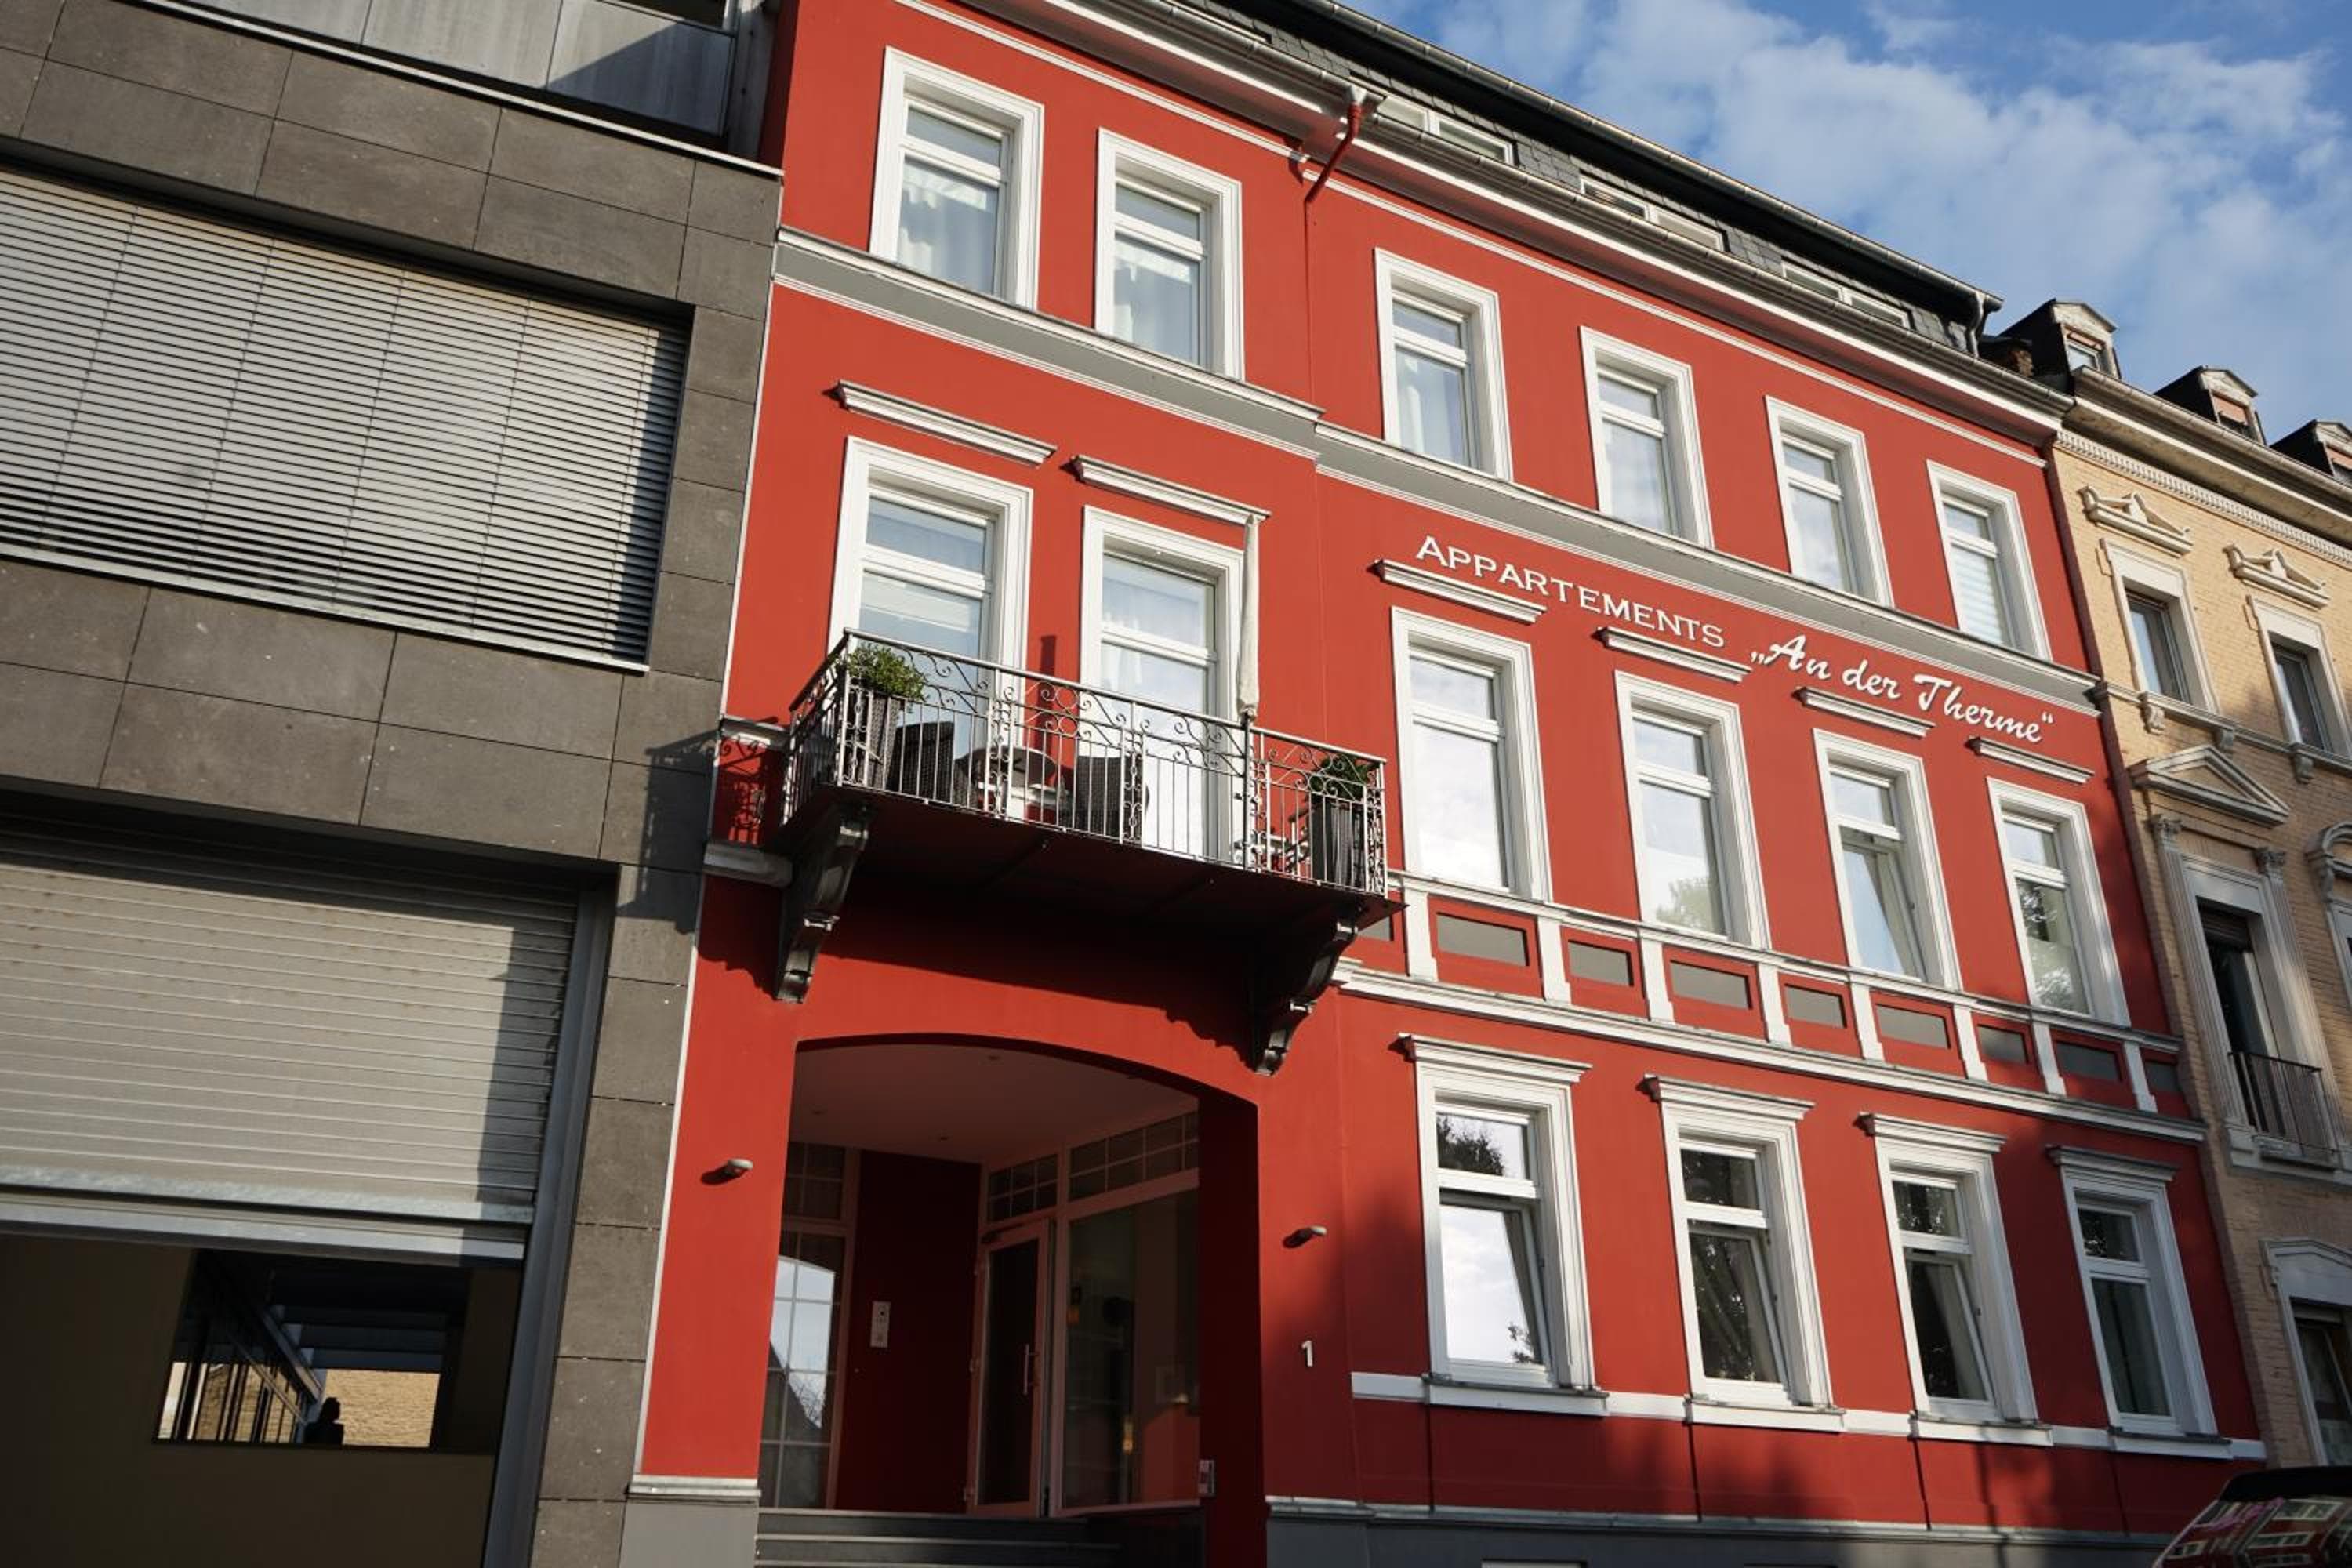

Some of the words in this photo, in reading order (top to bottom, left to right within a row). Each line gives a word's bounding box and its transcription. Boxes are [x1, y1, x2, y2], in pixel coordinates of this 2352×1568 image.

[1416, 535, 1725, 648] APPARTEMENTS
[1751, 634, 1831, 680] „An
[1842, 659, 1901, 700] der
[1913, 673, 2054, 743] Therme“
[1301, 1339, 1314, 1367] 1
